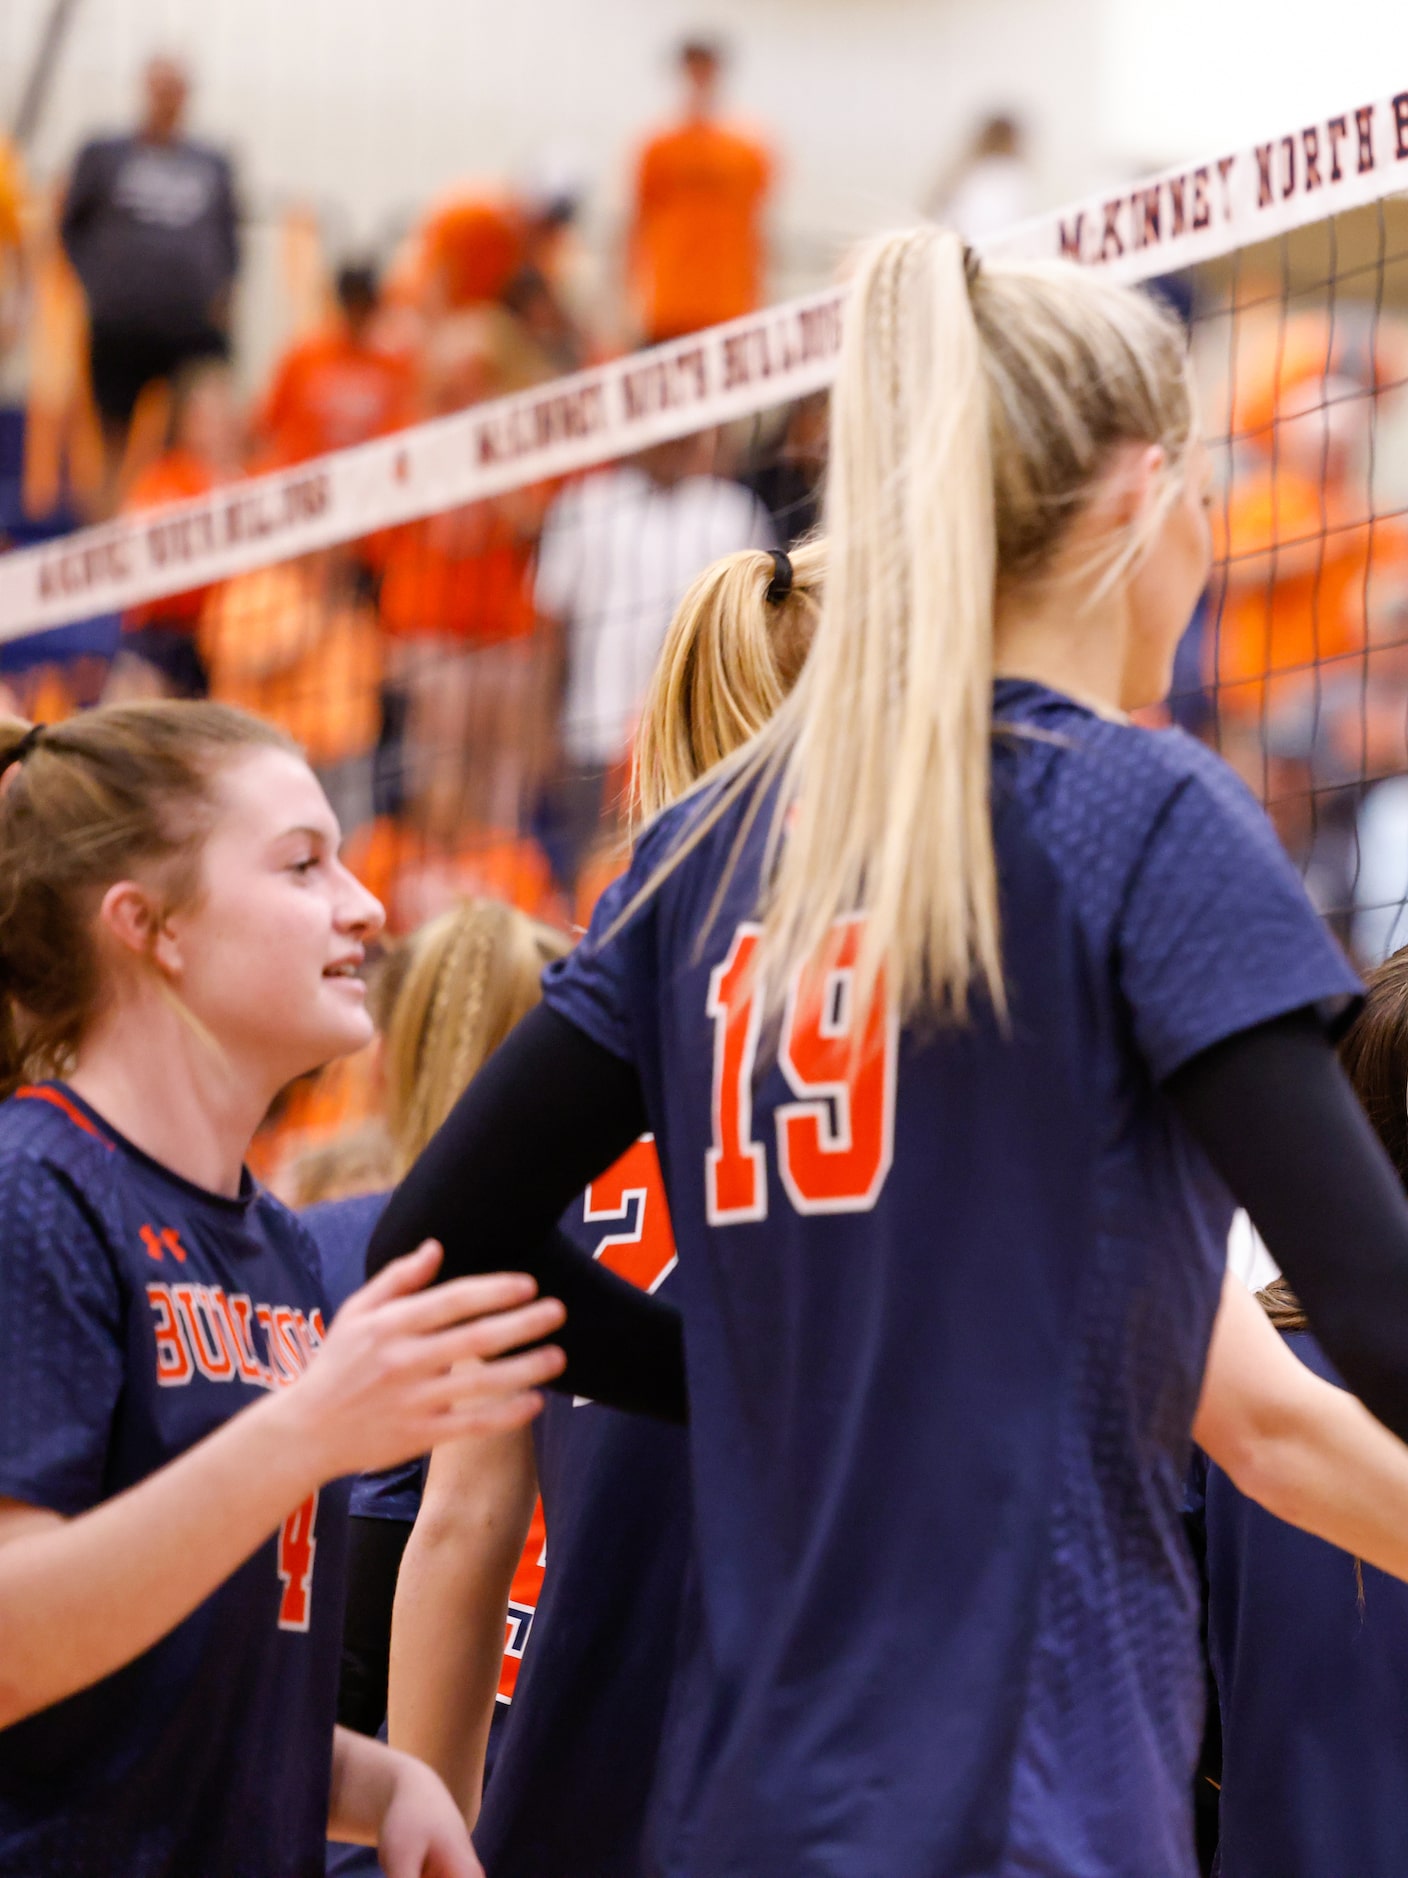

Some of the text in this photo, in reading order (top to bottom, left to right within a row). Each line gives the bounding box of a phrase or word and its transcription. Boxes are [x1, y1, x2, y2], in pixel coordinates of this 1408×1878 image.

[1057, 154, 1236, 264] MKINNEY
[1255, 101, 1376, 210] NORTH
[705, 910, 898, 1227] 19
[277, 1488, 319, 1633] 4
